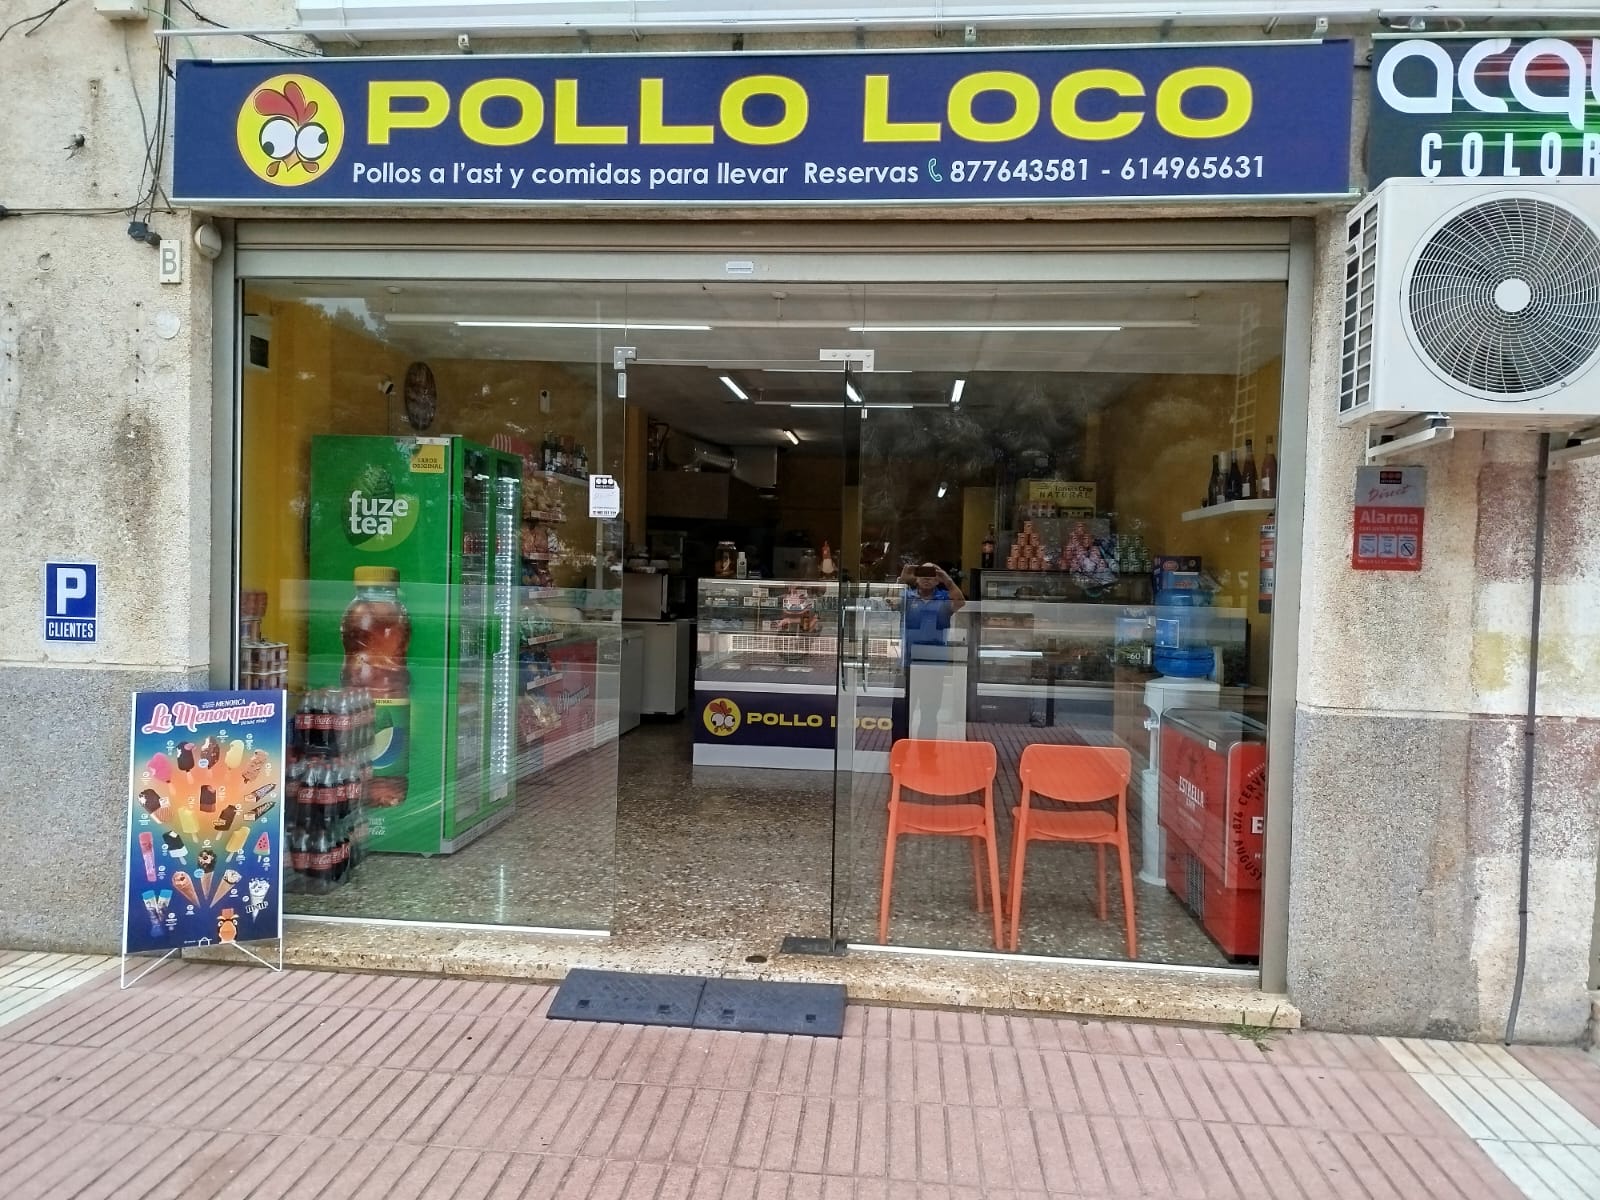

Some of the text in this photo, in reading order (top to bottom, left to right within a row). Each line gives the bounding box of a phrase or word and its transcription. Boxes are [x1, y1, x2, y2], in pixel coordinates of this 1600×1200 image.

[367, 66, 1253, 146] POLLO LOCO
[353, 162, 421, 184] Pollos
[429, 167, 445, 184] a
[453, 162, 502, 184] l'ast
[510, 167, 524, 189] y
[531, 162, 641, 185] comidas
[650, 167, 709, 190] para
[717, 162, 789, 184] llevar
[804, 162, 919, 184] Reservas
[950, 158, 1089, 183] 877643581
[1120, 155, 1264, 180] 614965631
[162, 247, 177, 275] B
[349, 490, 409, 517] fuze
[349, 515, 393, 535] tea
[1360, 510, 1418, 525] Alarma
[56, 568, 87, 615] P
[48, 621, 94, 638] CLIENTES
[142, 703, 174, 734] La
[172, 702, 275, 732] Menorquina
[747, 712, 823, 728] POLLO
